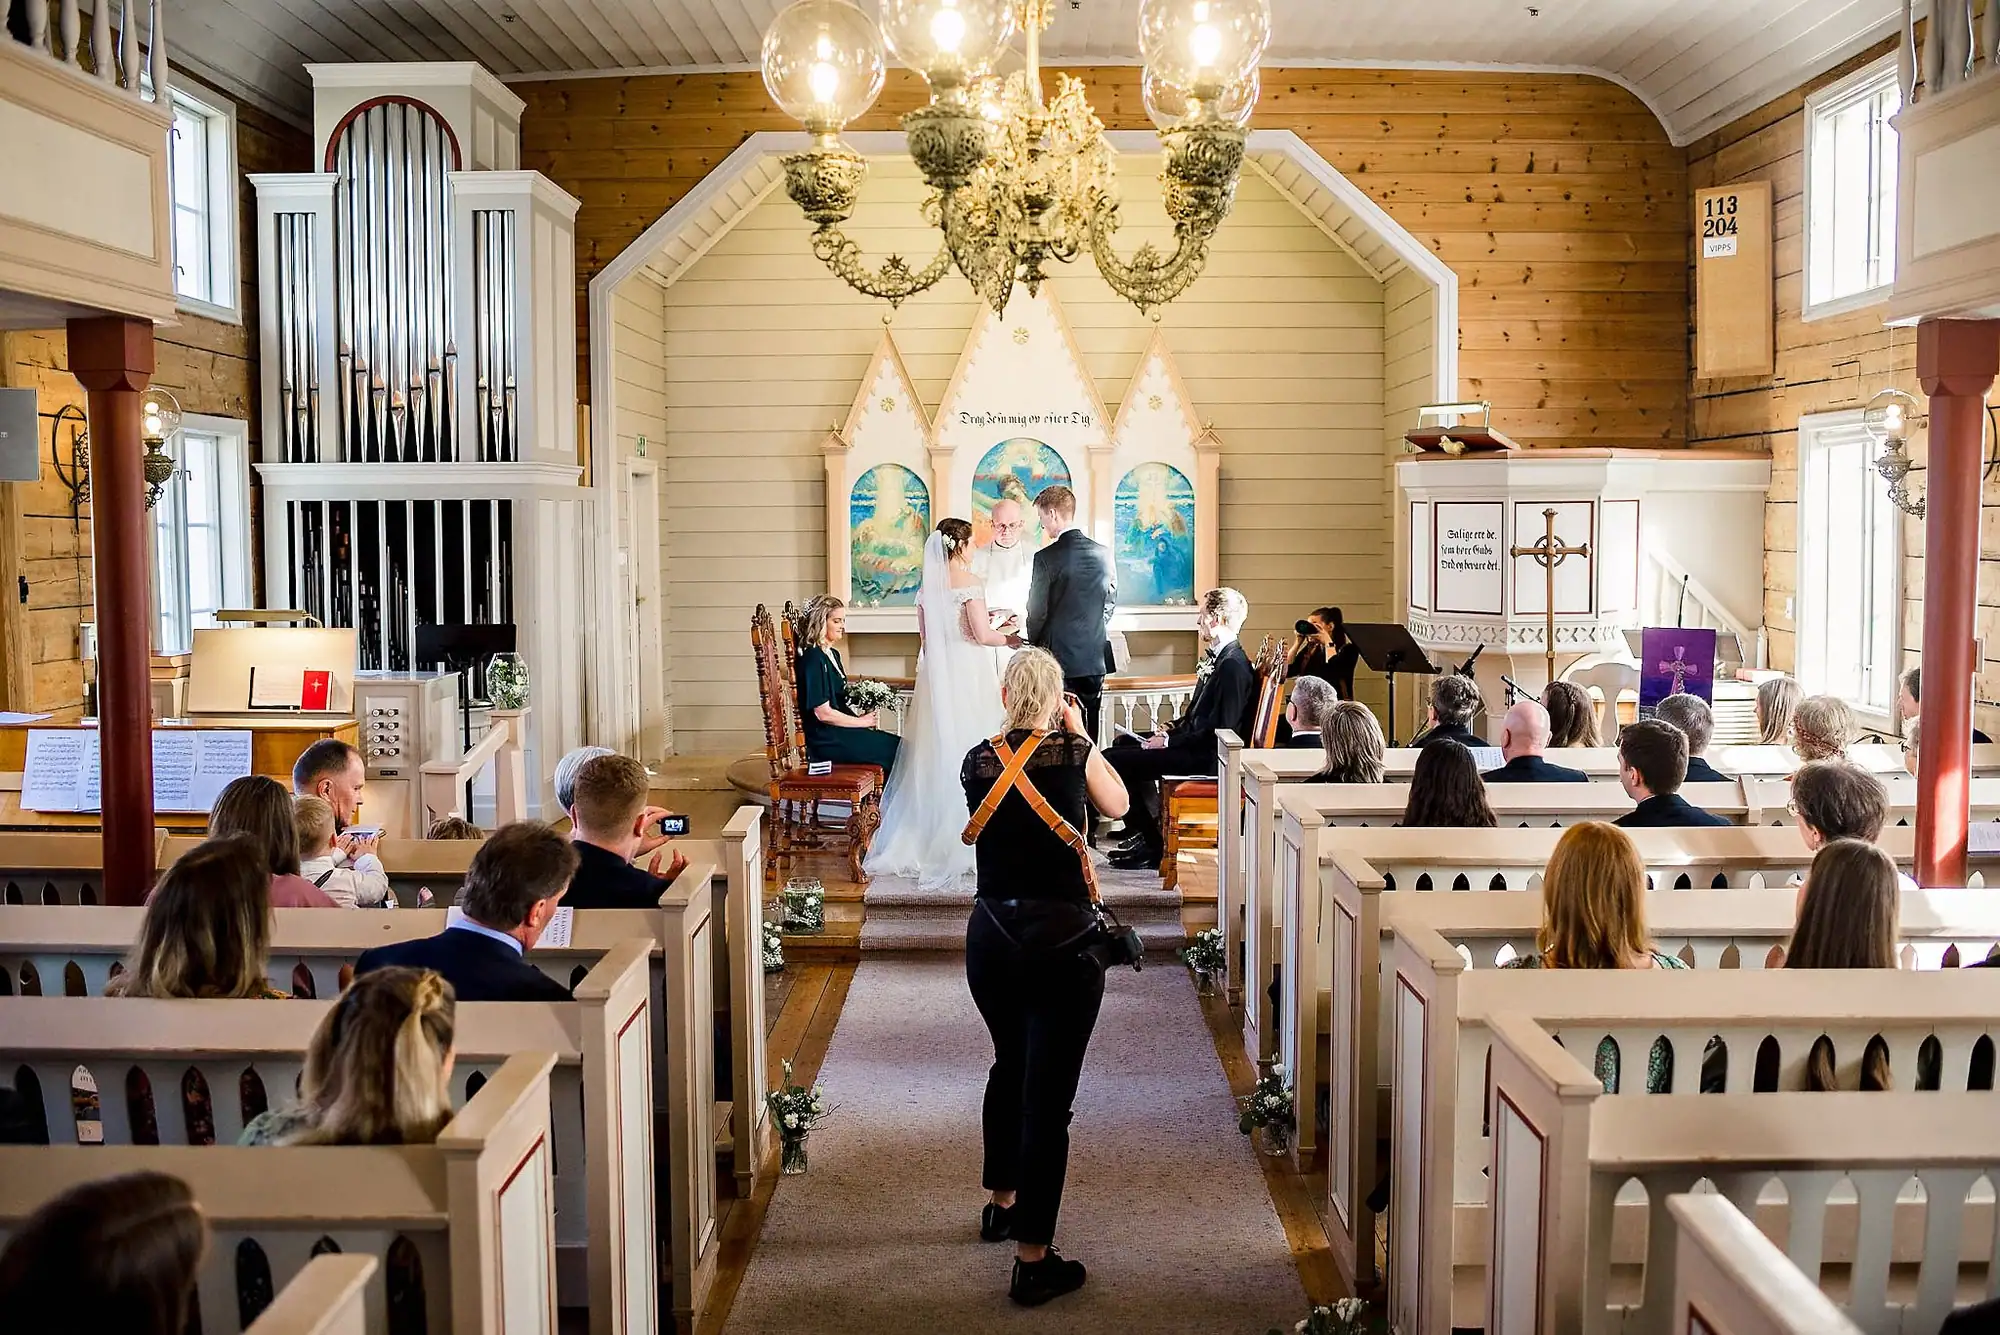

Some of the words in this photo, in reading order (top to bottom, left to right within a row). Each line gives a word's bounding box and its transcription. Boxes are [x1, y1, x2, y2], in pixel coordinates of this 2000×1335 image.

[1704, 196, 1738, 217] 113
[1703, 217, 1738, 238] 204
[1709, 243, 1732, 253] VIPPS
